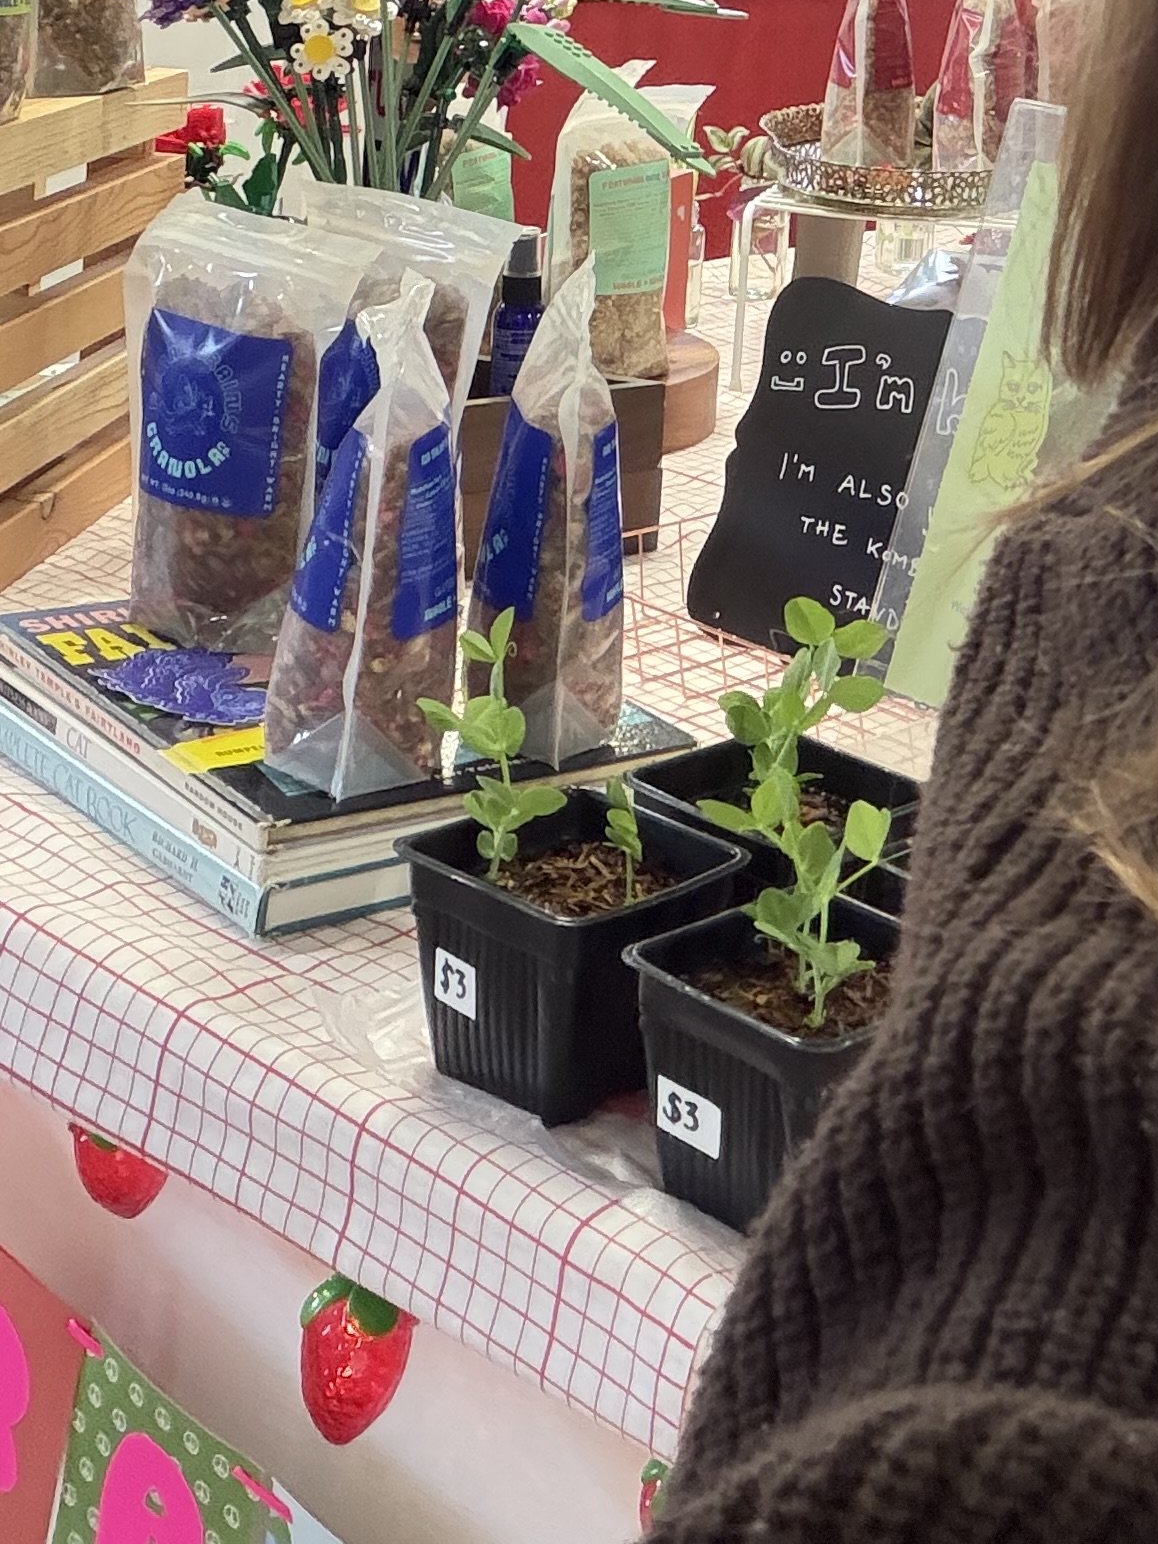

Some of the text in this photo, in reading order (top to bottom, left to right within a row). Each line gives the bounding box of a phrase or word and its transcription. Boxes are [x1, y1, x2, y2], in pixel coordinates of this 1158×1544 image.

[146, 421, 226, 480] GRANOLA
[779, 452, 910, 511] I'M ALSO
[801, 515, 849, 546] THE
[66, 726, 92, 759] CAT
[86, 784, 138, 844] BOOK
[440, 958, 467, 999] $3
[662, 1091, 700, 1133] $3
